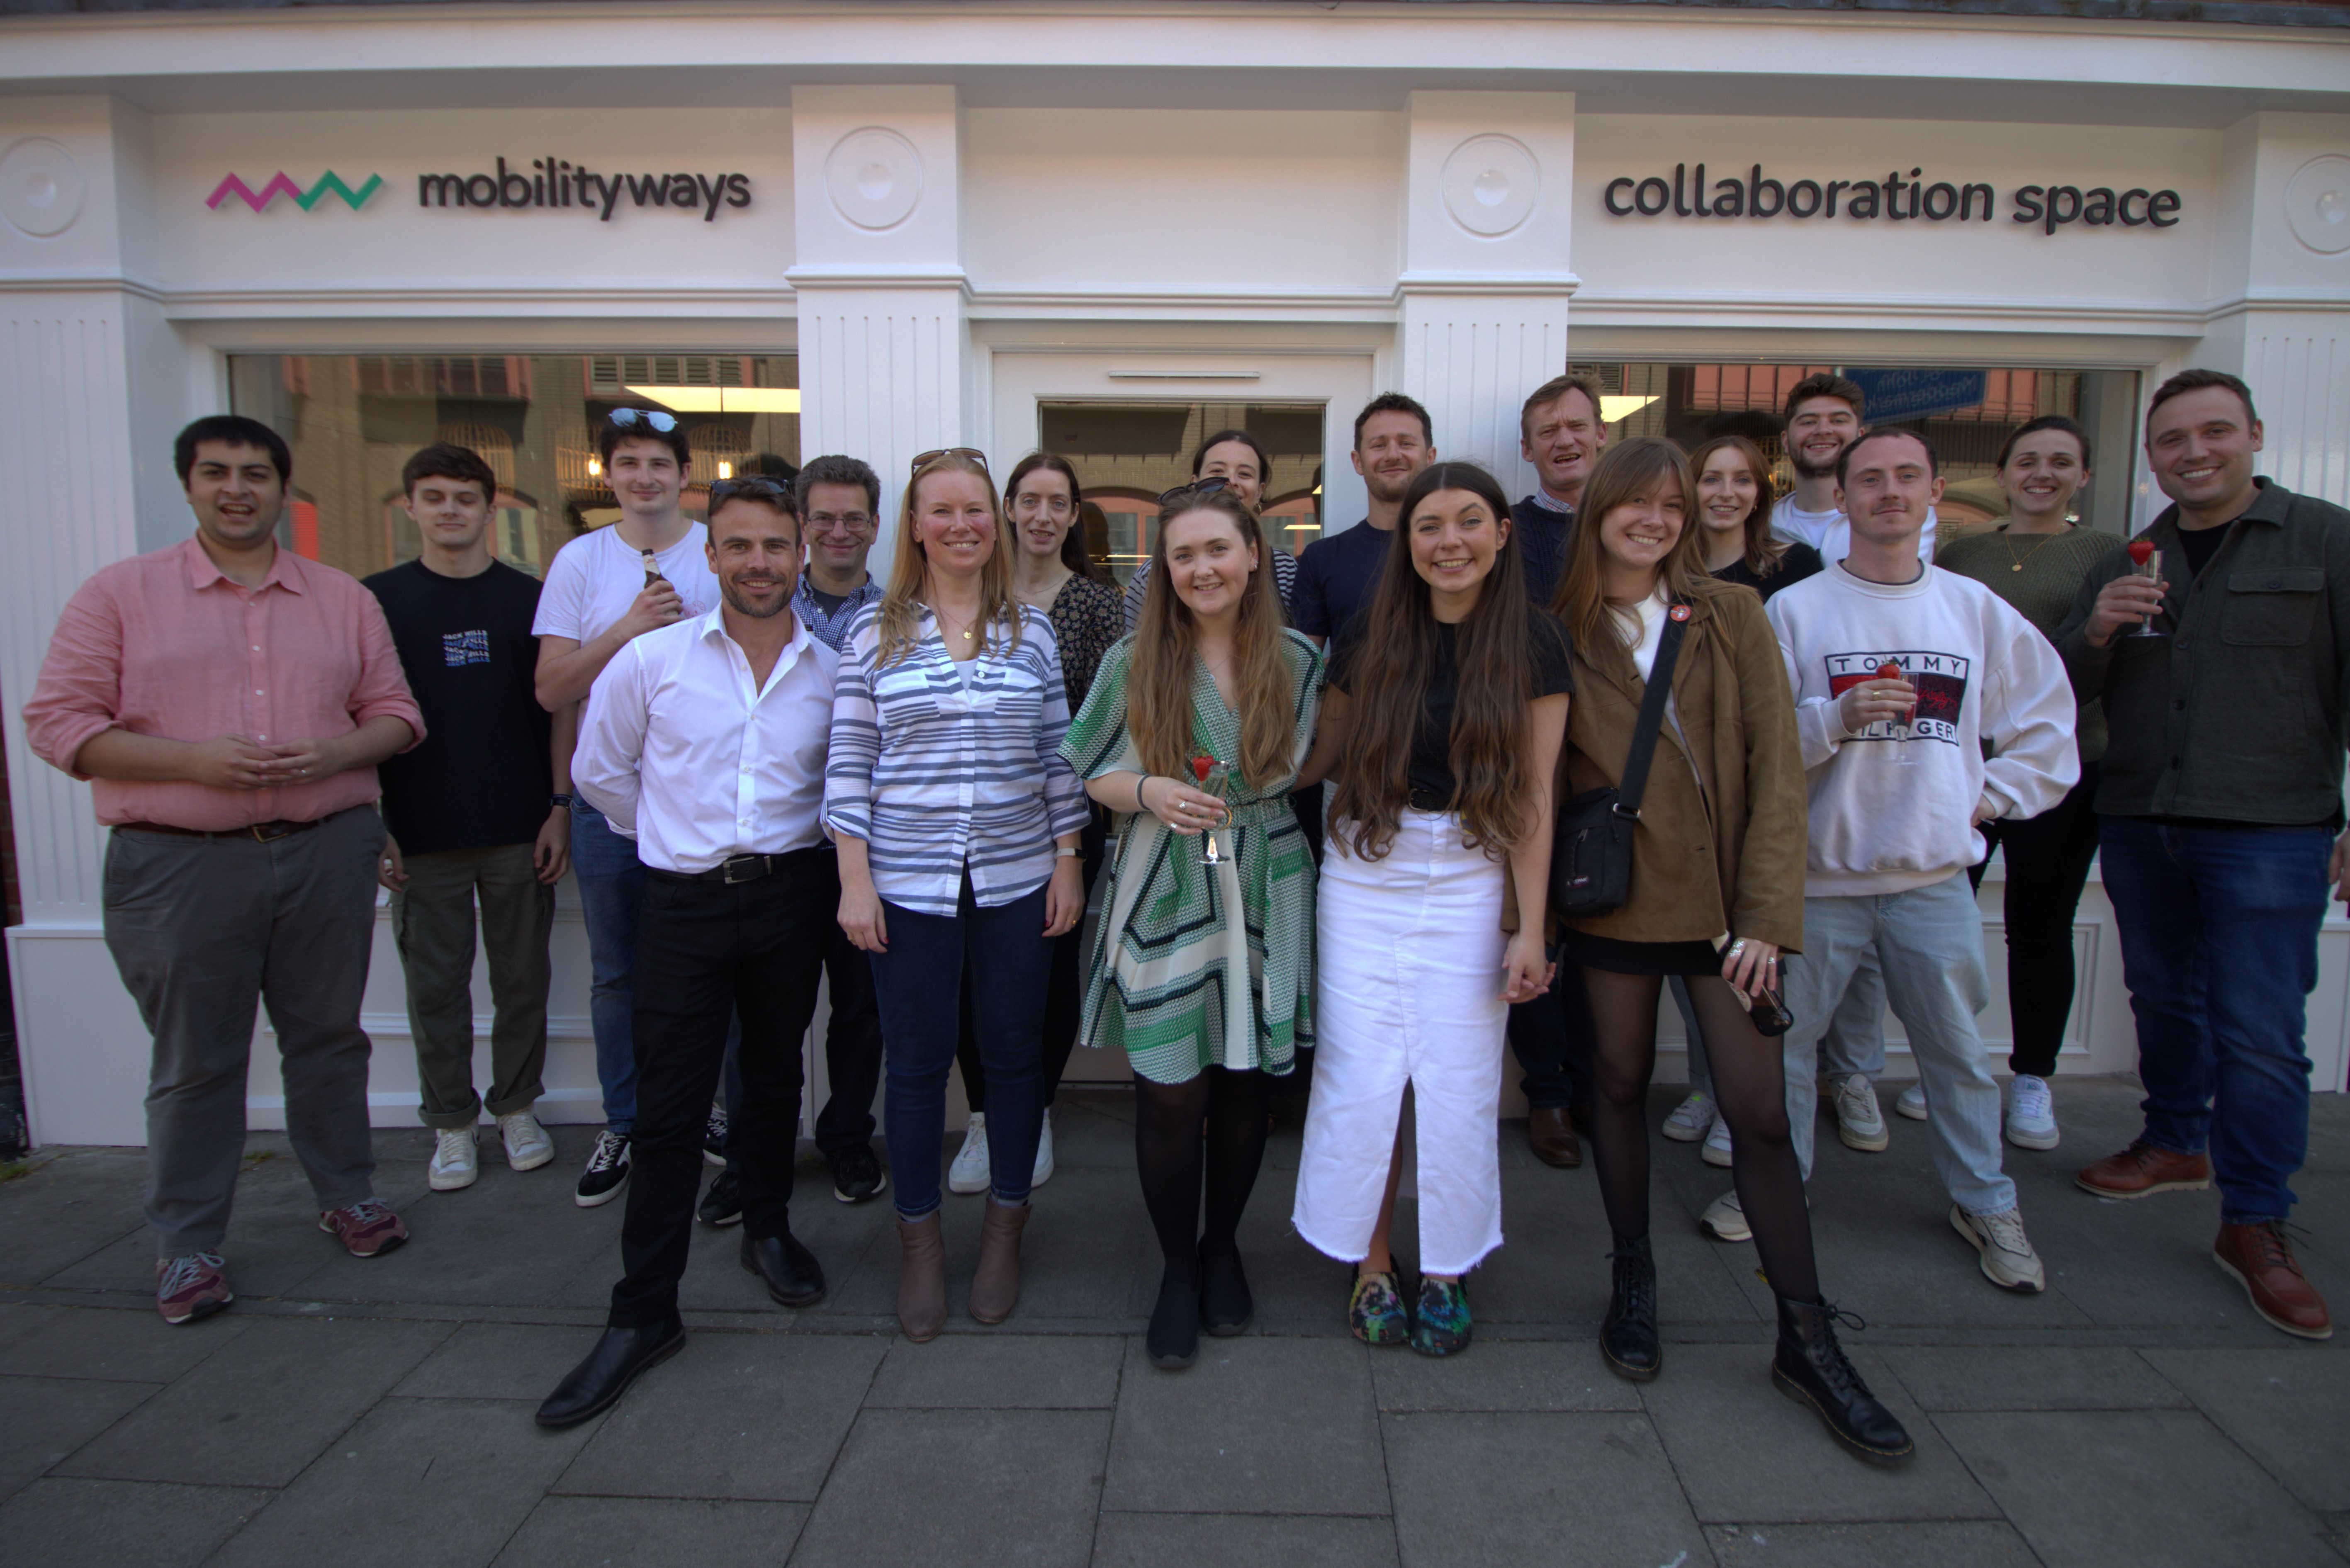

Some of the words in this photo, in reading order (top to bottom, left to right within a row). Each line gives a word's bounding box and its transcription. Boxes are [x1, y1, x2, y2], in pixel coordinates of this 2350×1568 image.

[420, 157, 751, 221] mobilityways
[1604, 163, 1994, 221] collaboration
[2012, 185, 2181, 236] space
[1834, 656, 1960, 674] TOMMY
